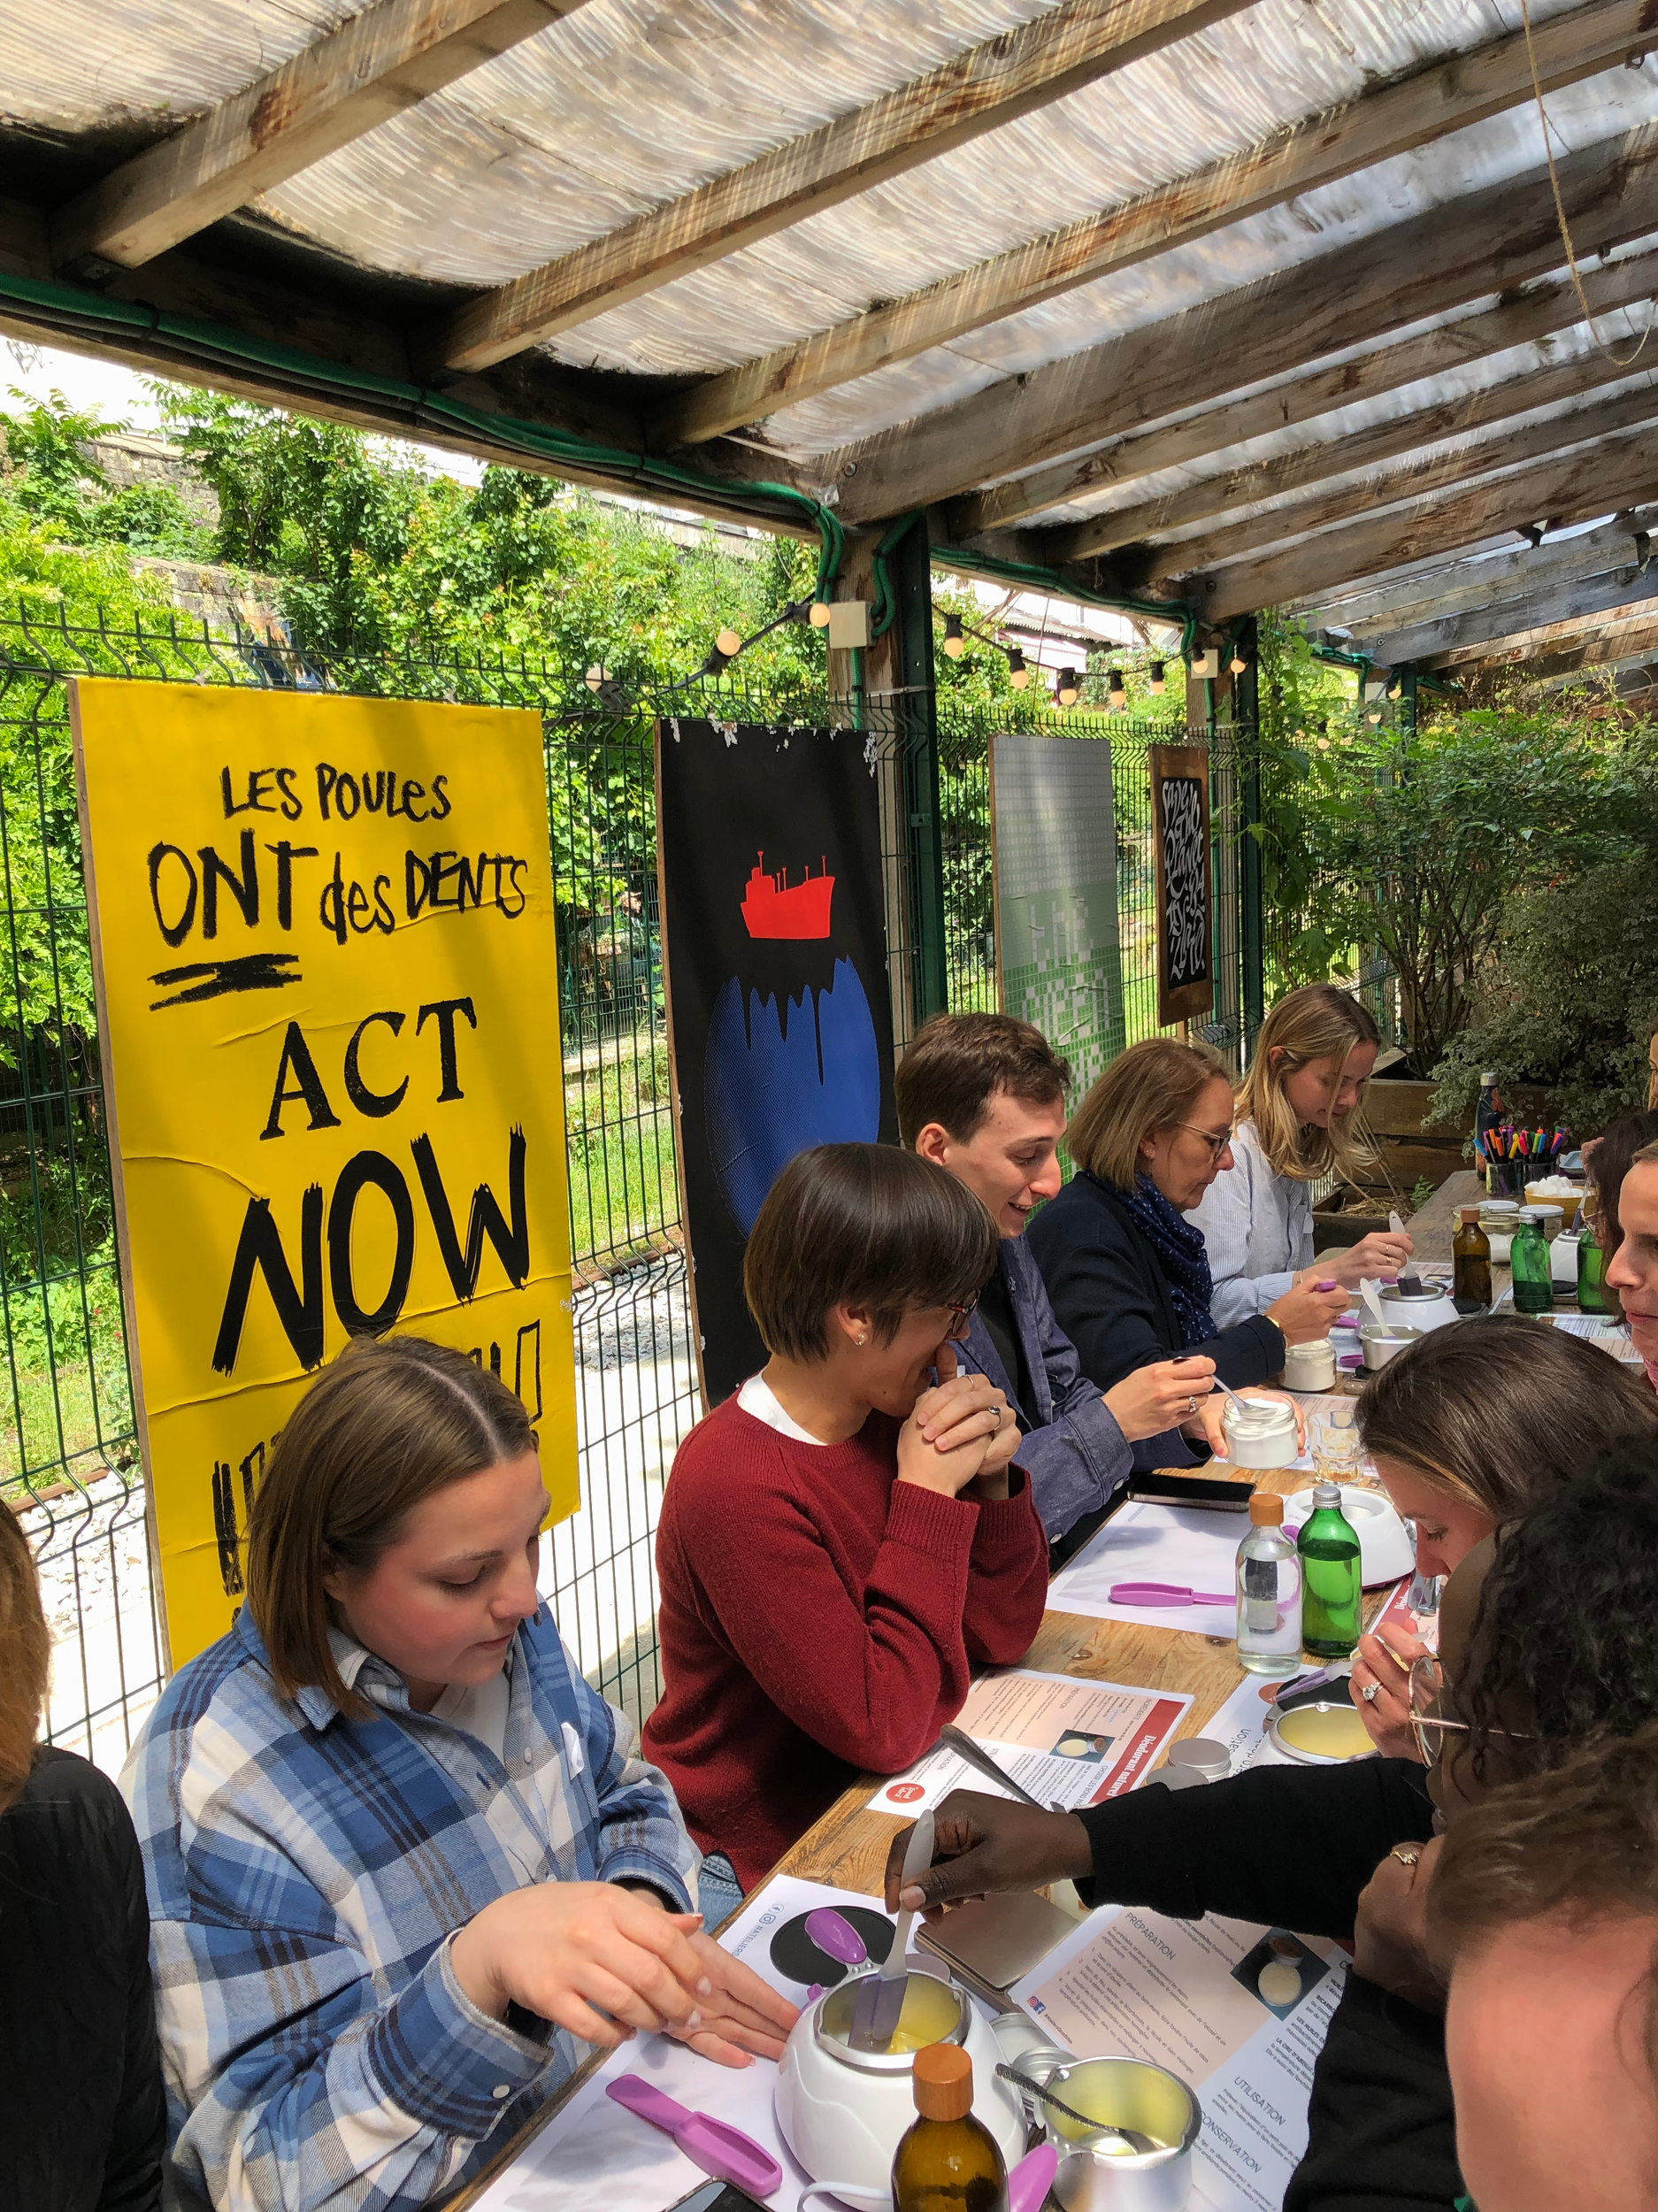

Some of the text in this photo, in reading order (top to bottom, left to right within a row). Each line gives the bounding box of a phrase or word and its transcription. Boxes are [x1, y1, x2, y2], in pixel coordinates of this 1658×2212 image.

[219, 765, 303, 821] LES
[148, 829, 528, 948] ONT des DENTS
[259, 997, 477, 1141] ACT
[211, 1122, 530, 1376] NOW
[1105, 1734, 1157, 1797] Déodorant naturel
[731, 1924, 763, 1957] #ATELIERS
[1125, 1910, 1176, 1960] PRÉPARATION
[1232, 2075, 1286, 2126] UTILISATION
